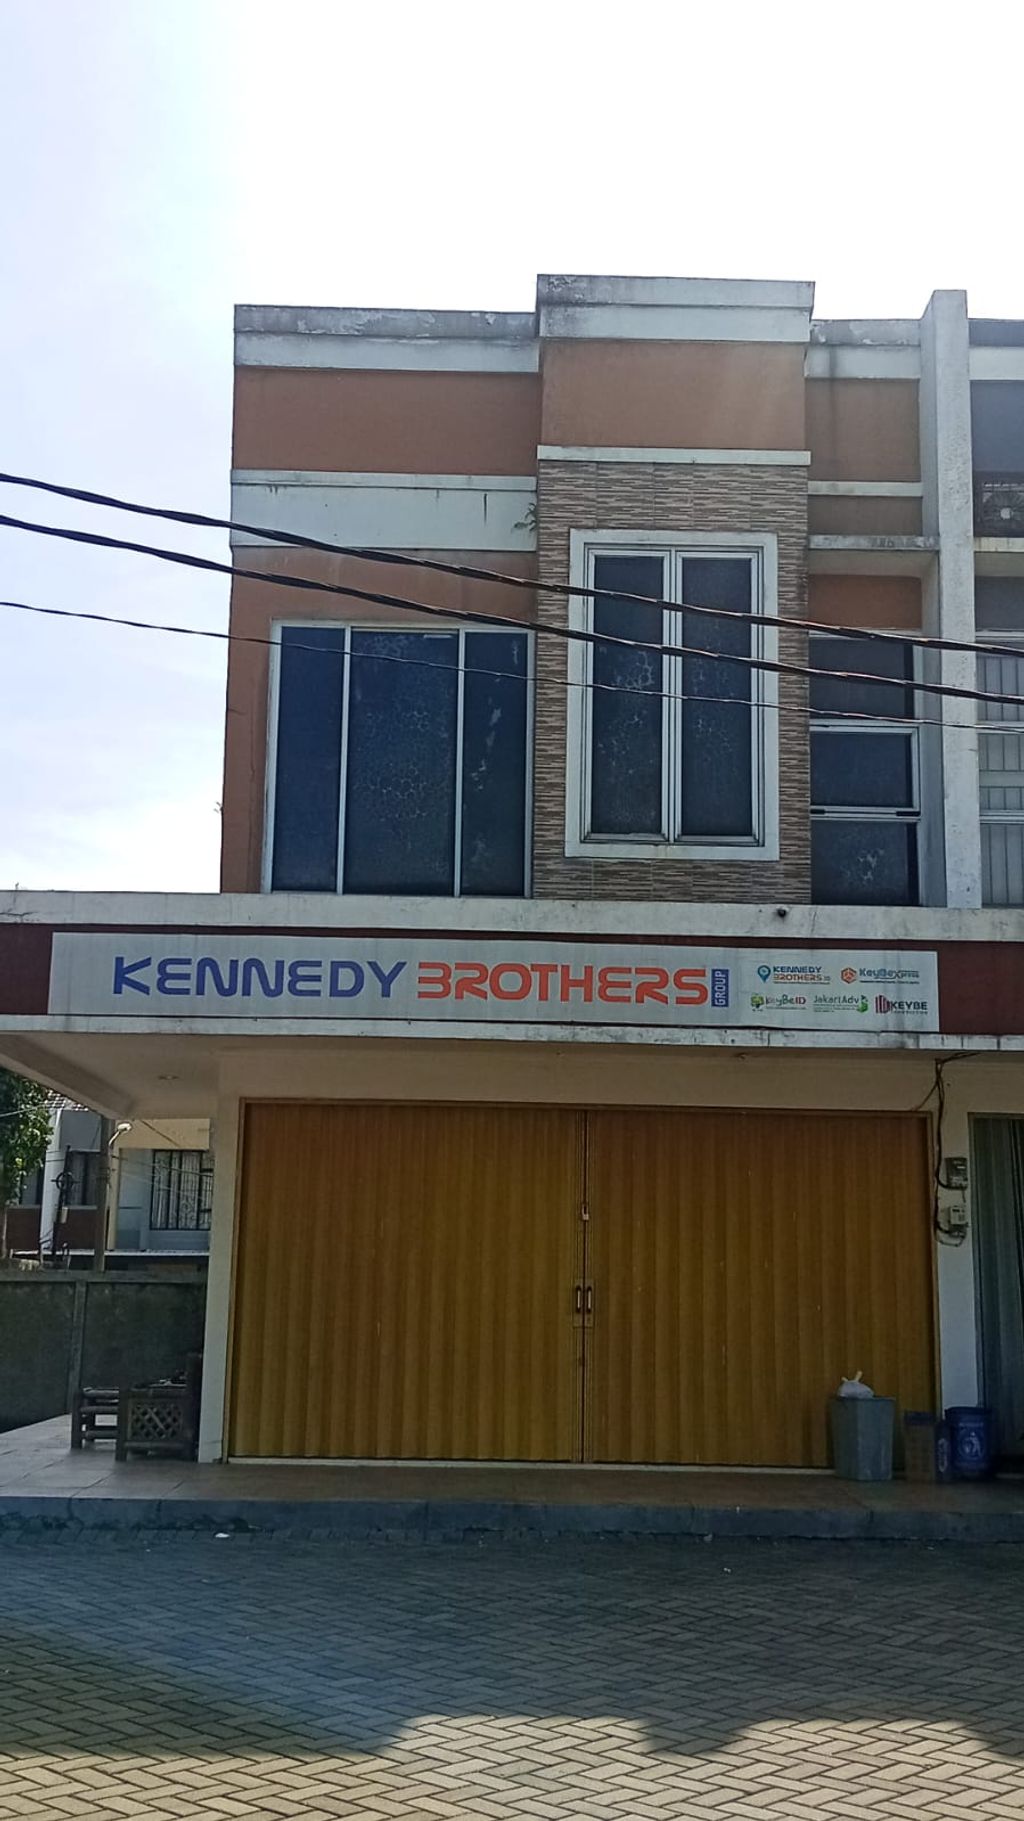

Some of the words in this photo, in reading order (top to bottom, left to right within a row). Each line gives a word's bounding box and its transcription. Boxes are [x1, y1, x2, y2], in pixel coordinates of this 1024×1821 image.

[113, 956, 406, 998] KENNEDY
[417, 962, 708, 1005] BROTHERS
[714, 970, 726, 1005] GROUP
[891, 1001, 928, 1010] KEYBE
